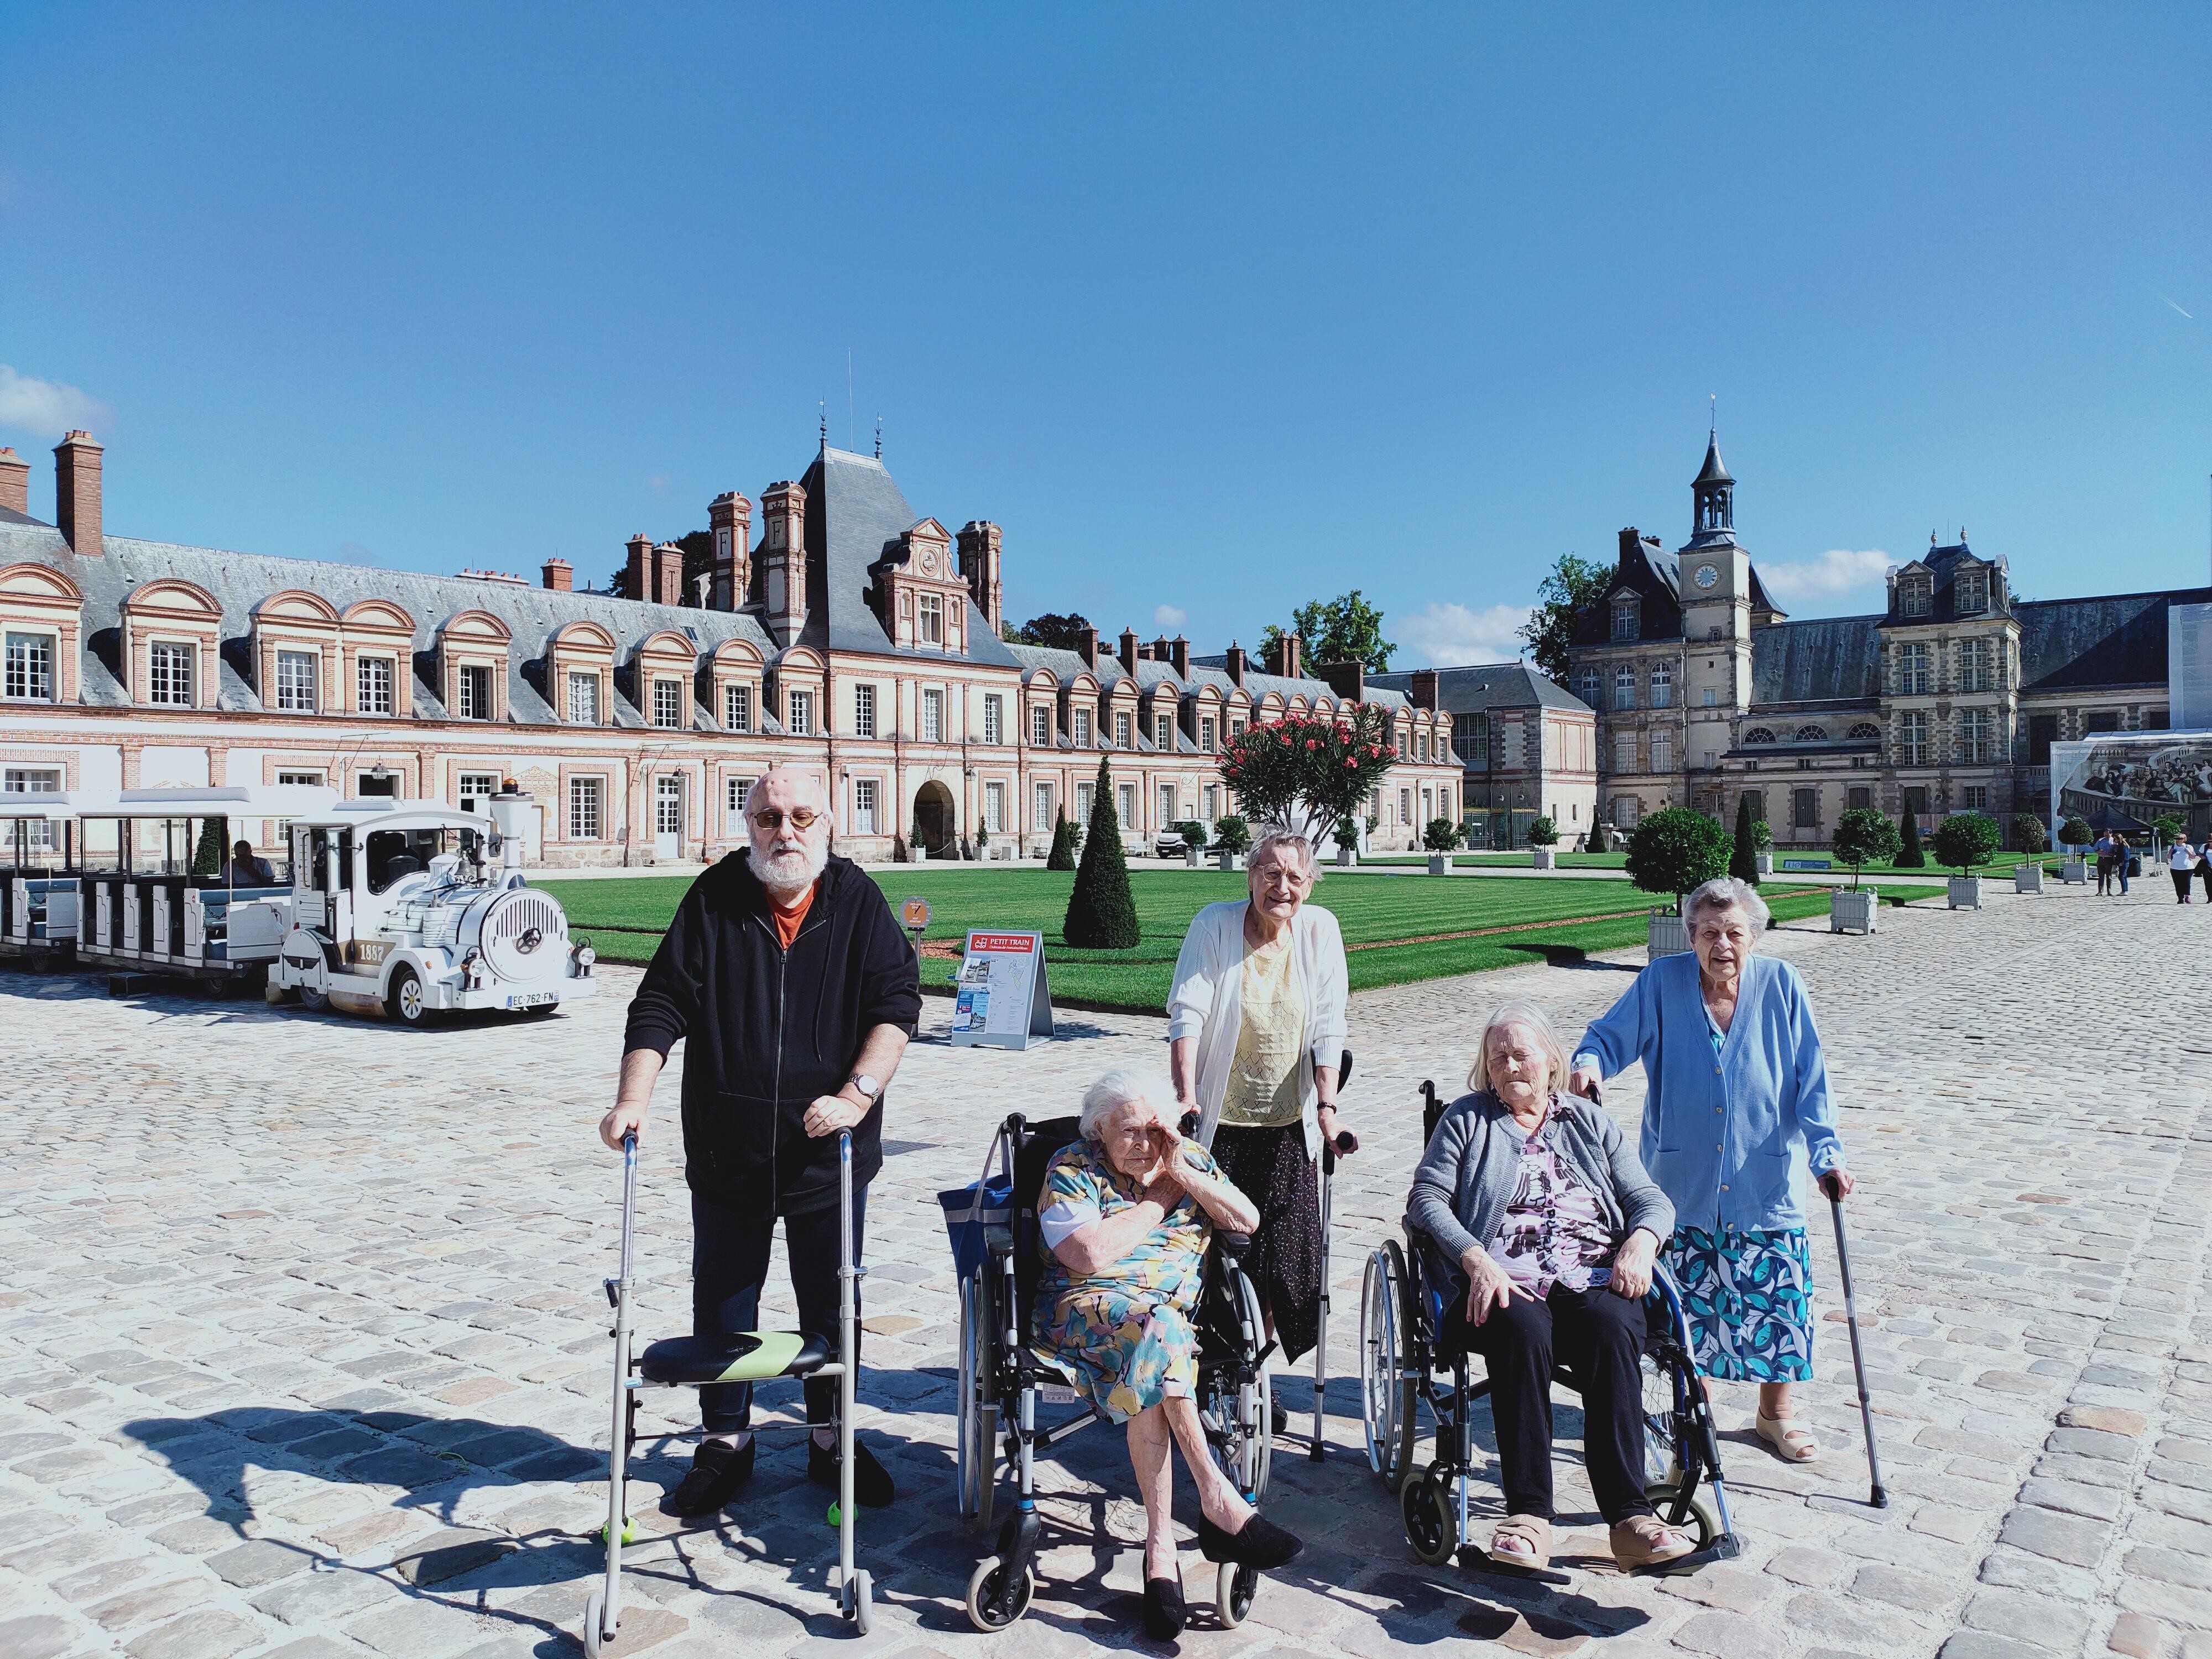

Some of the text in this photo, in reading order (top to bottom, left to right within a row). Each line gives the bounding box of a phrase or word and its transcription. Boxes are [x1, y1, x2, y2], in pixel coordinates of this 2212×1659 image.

[719, 532, 728, 555] F
[772, 520, 782, 544] F
[360, 944, 384, 962] 1887
